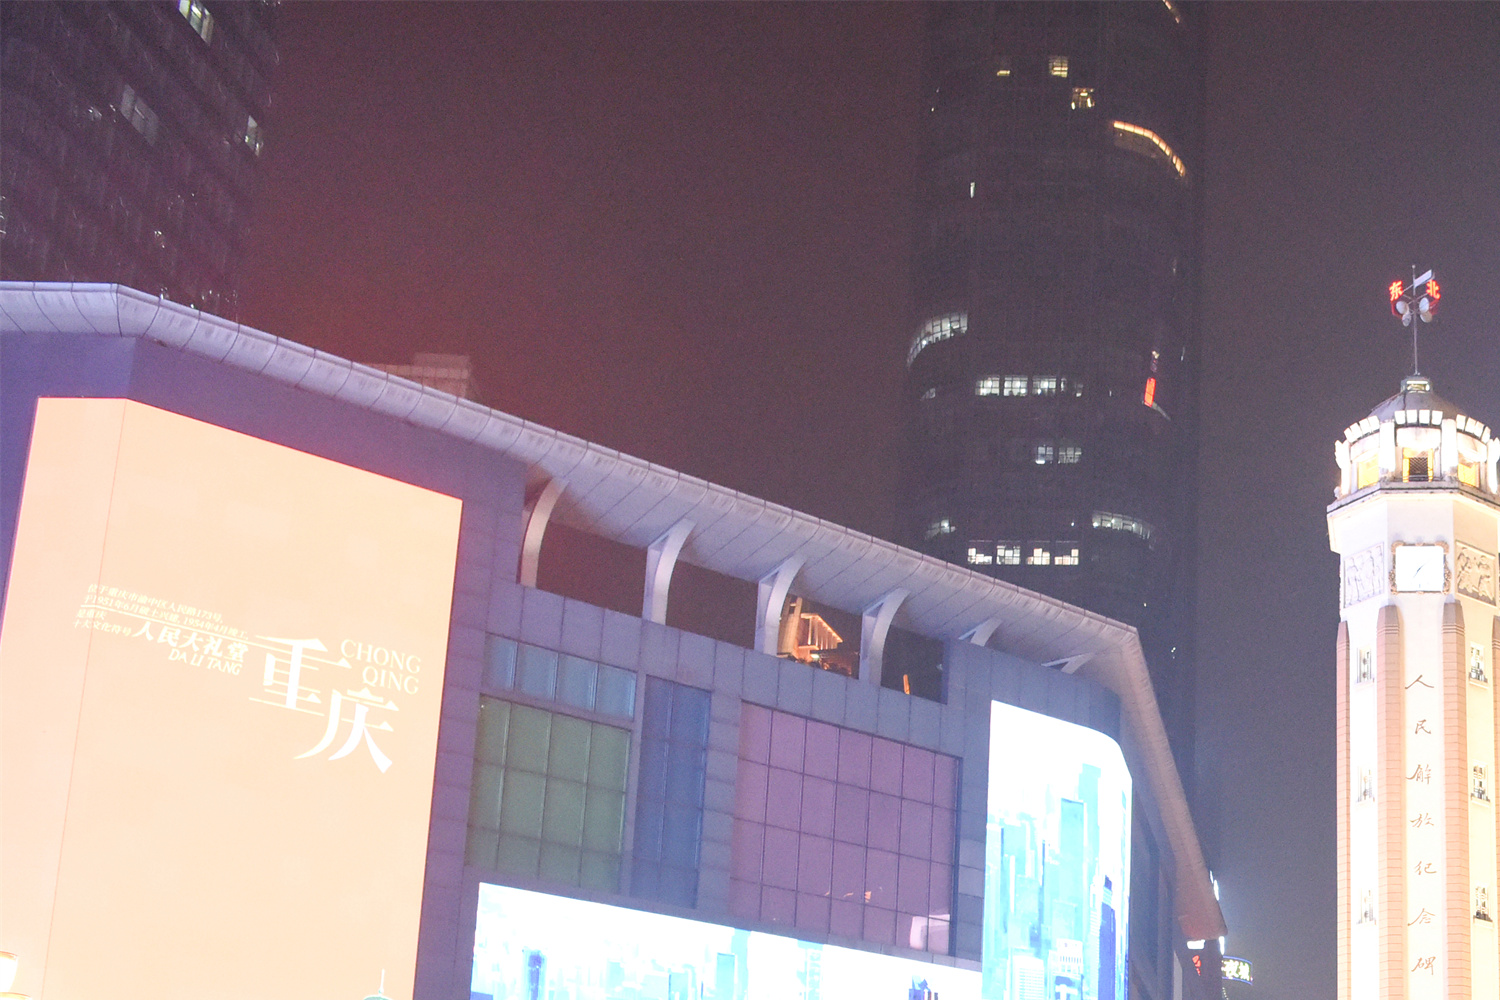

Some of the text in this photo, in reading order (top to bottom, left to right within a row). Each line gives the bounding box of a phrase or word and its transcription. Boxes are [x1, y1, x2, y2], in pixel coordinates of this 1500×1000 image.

[1389, 280, 1403, 301] 东
[1426, 279, 1441, 300] 北
[131, 620, 250, 664] 人民大礼堂
[340, 638, 422, 674] CHONG
[168, 648, 188, 664] DA
[206, 655, 243, 676] TANG
[362, 666, 420, 695] QING
[249, 633, 399, 774] 重庆
[1221, 959, 1250, 981] 夜城
